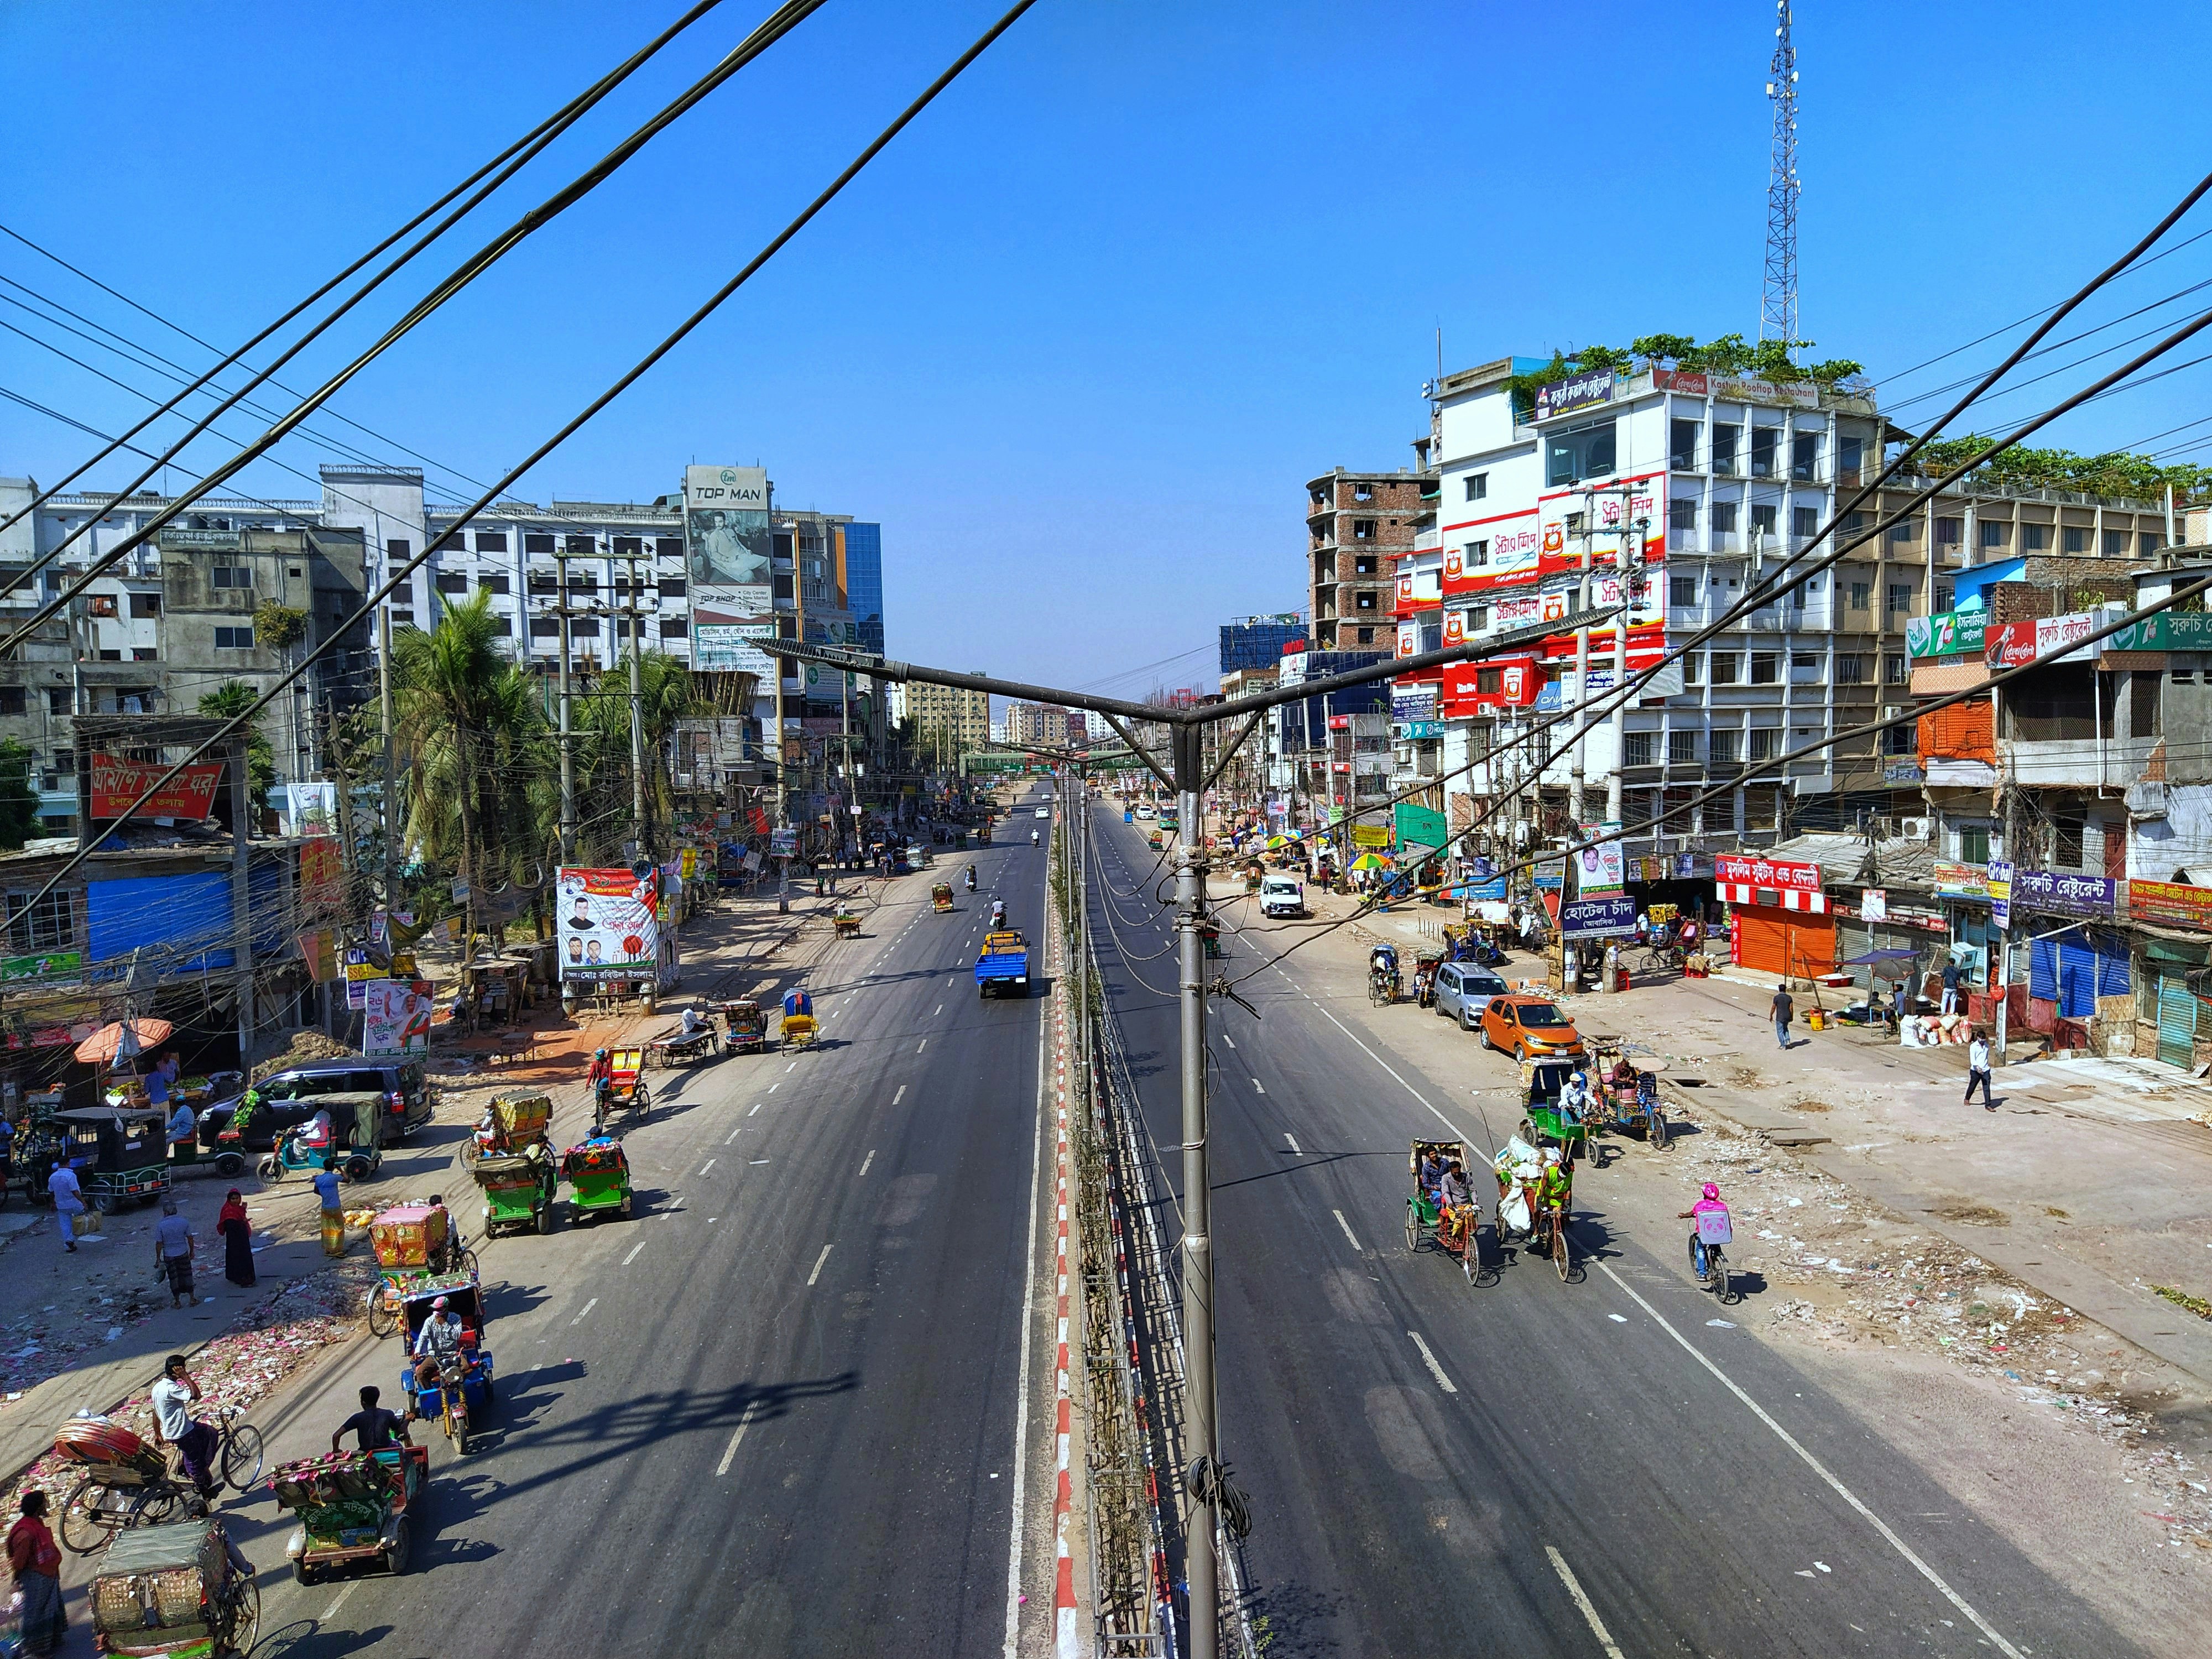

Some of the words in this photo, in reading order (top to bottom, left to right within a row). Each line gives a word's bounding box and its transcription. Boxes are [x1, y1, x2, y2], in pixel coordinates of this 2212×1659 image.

[1741, 381, 1772, 396] Rooftop
[1774, 384, 1814, 398] Restaurant
[696, 488, 725, 499] TOP
[730, 489, 760, 500] MAN
[1957, 611, 1987, 629] ইসলামিয়া
[2168, 614, 2203, 637] সুরুচি
[2039, 619, 2059, 649] সুরুচি
[1726, 858, 1750, 880] মুসলিম
[1777, 867, 1790, 883] এন্ড
[1564, 902, 1607, 921] হোটেল
[1610, 900, 1634, 915] চাঁদ
[1583, 918, 1616, 928] (আবাসিক)
[581, 971, 597, 979] মোঃ
[599, 969, 625, 979] রবিউল
[627, 970, 654, 978] ইসলাম
[368, 997, 383, 1005] ২৬
